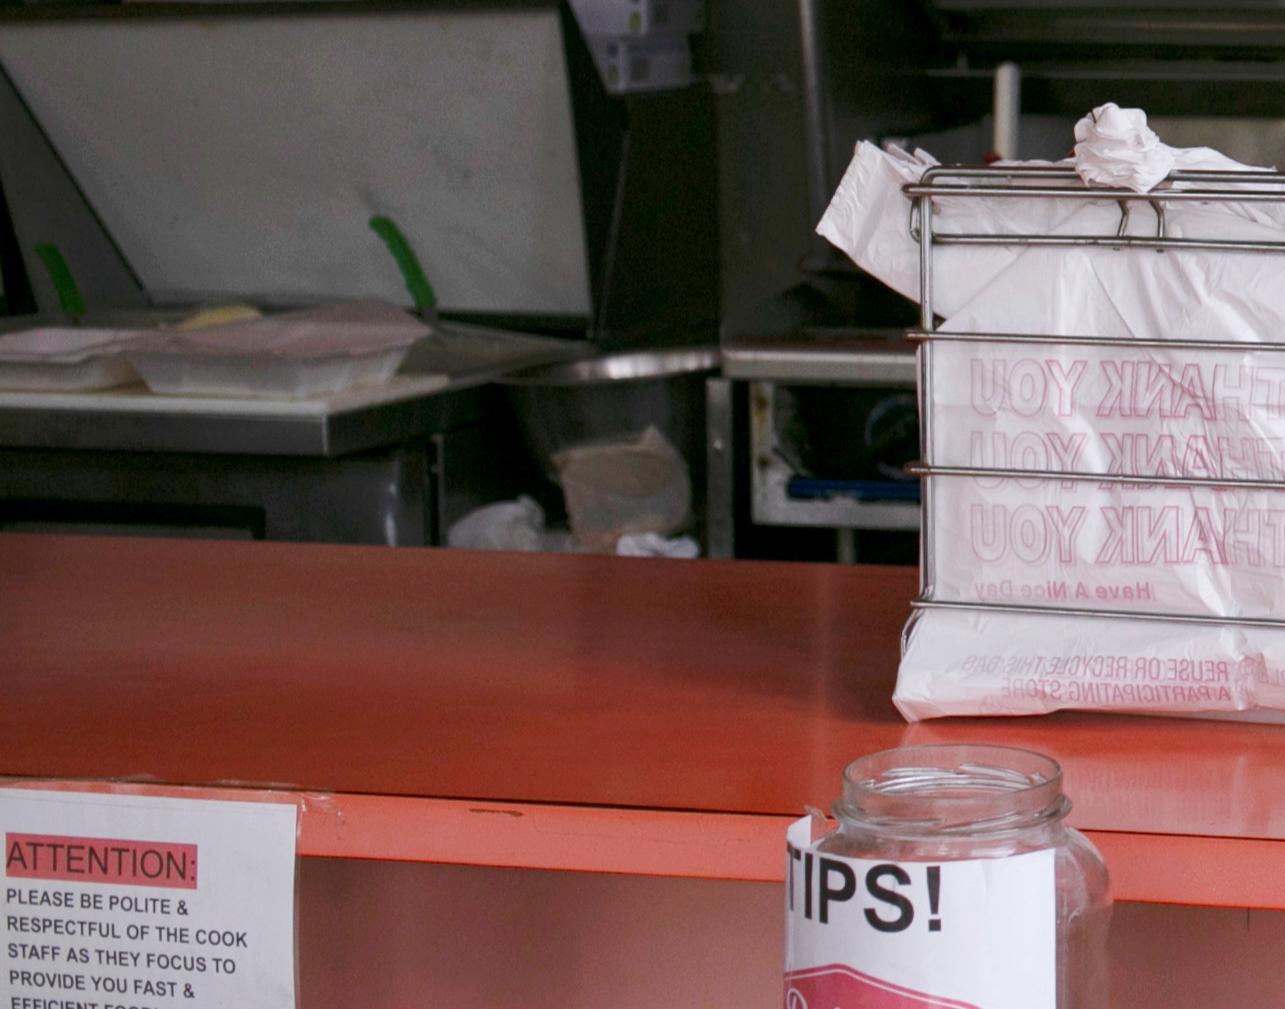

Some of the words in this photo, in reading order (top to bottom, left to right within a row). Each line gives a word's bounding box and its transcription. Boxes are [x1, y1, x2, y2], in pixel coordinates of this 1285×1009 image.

[6, 841, 197, 882] ATTENTION:
[6, 888, 75, 908] PLEASE
[80, 894, 103, 910] BE
[109, 895, 171, 915] POLITE
[177, 900, 189, 915] &
[788, 846, 942, 933] TIPS!
[7, 916, 120, 939] RESPECTFUL
[126, 924, 150, 941] OF
[155, 926, 190, 943] THE
[195, 929, 248, 948] COOK
[8, 943, 60, 961] STAFF
[66, 947, 90, 964] AS
[95, 949, 141, 968] THEY
[146, 953, 207, 973] FOCUS
[212, 958, 236, 975] TO
[9, 970, 86, 991] PROVIDE
[91, 976, 128, 994] YOU
[134, 979, 177, 998] FAST
[183, 983, 195, 999] &
